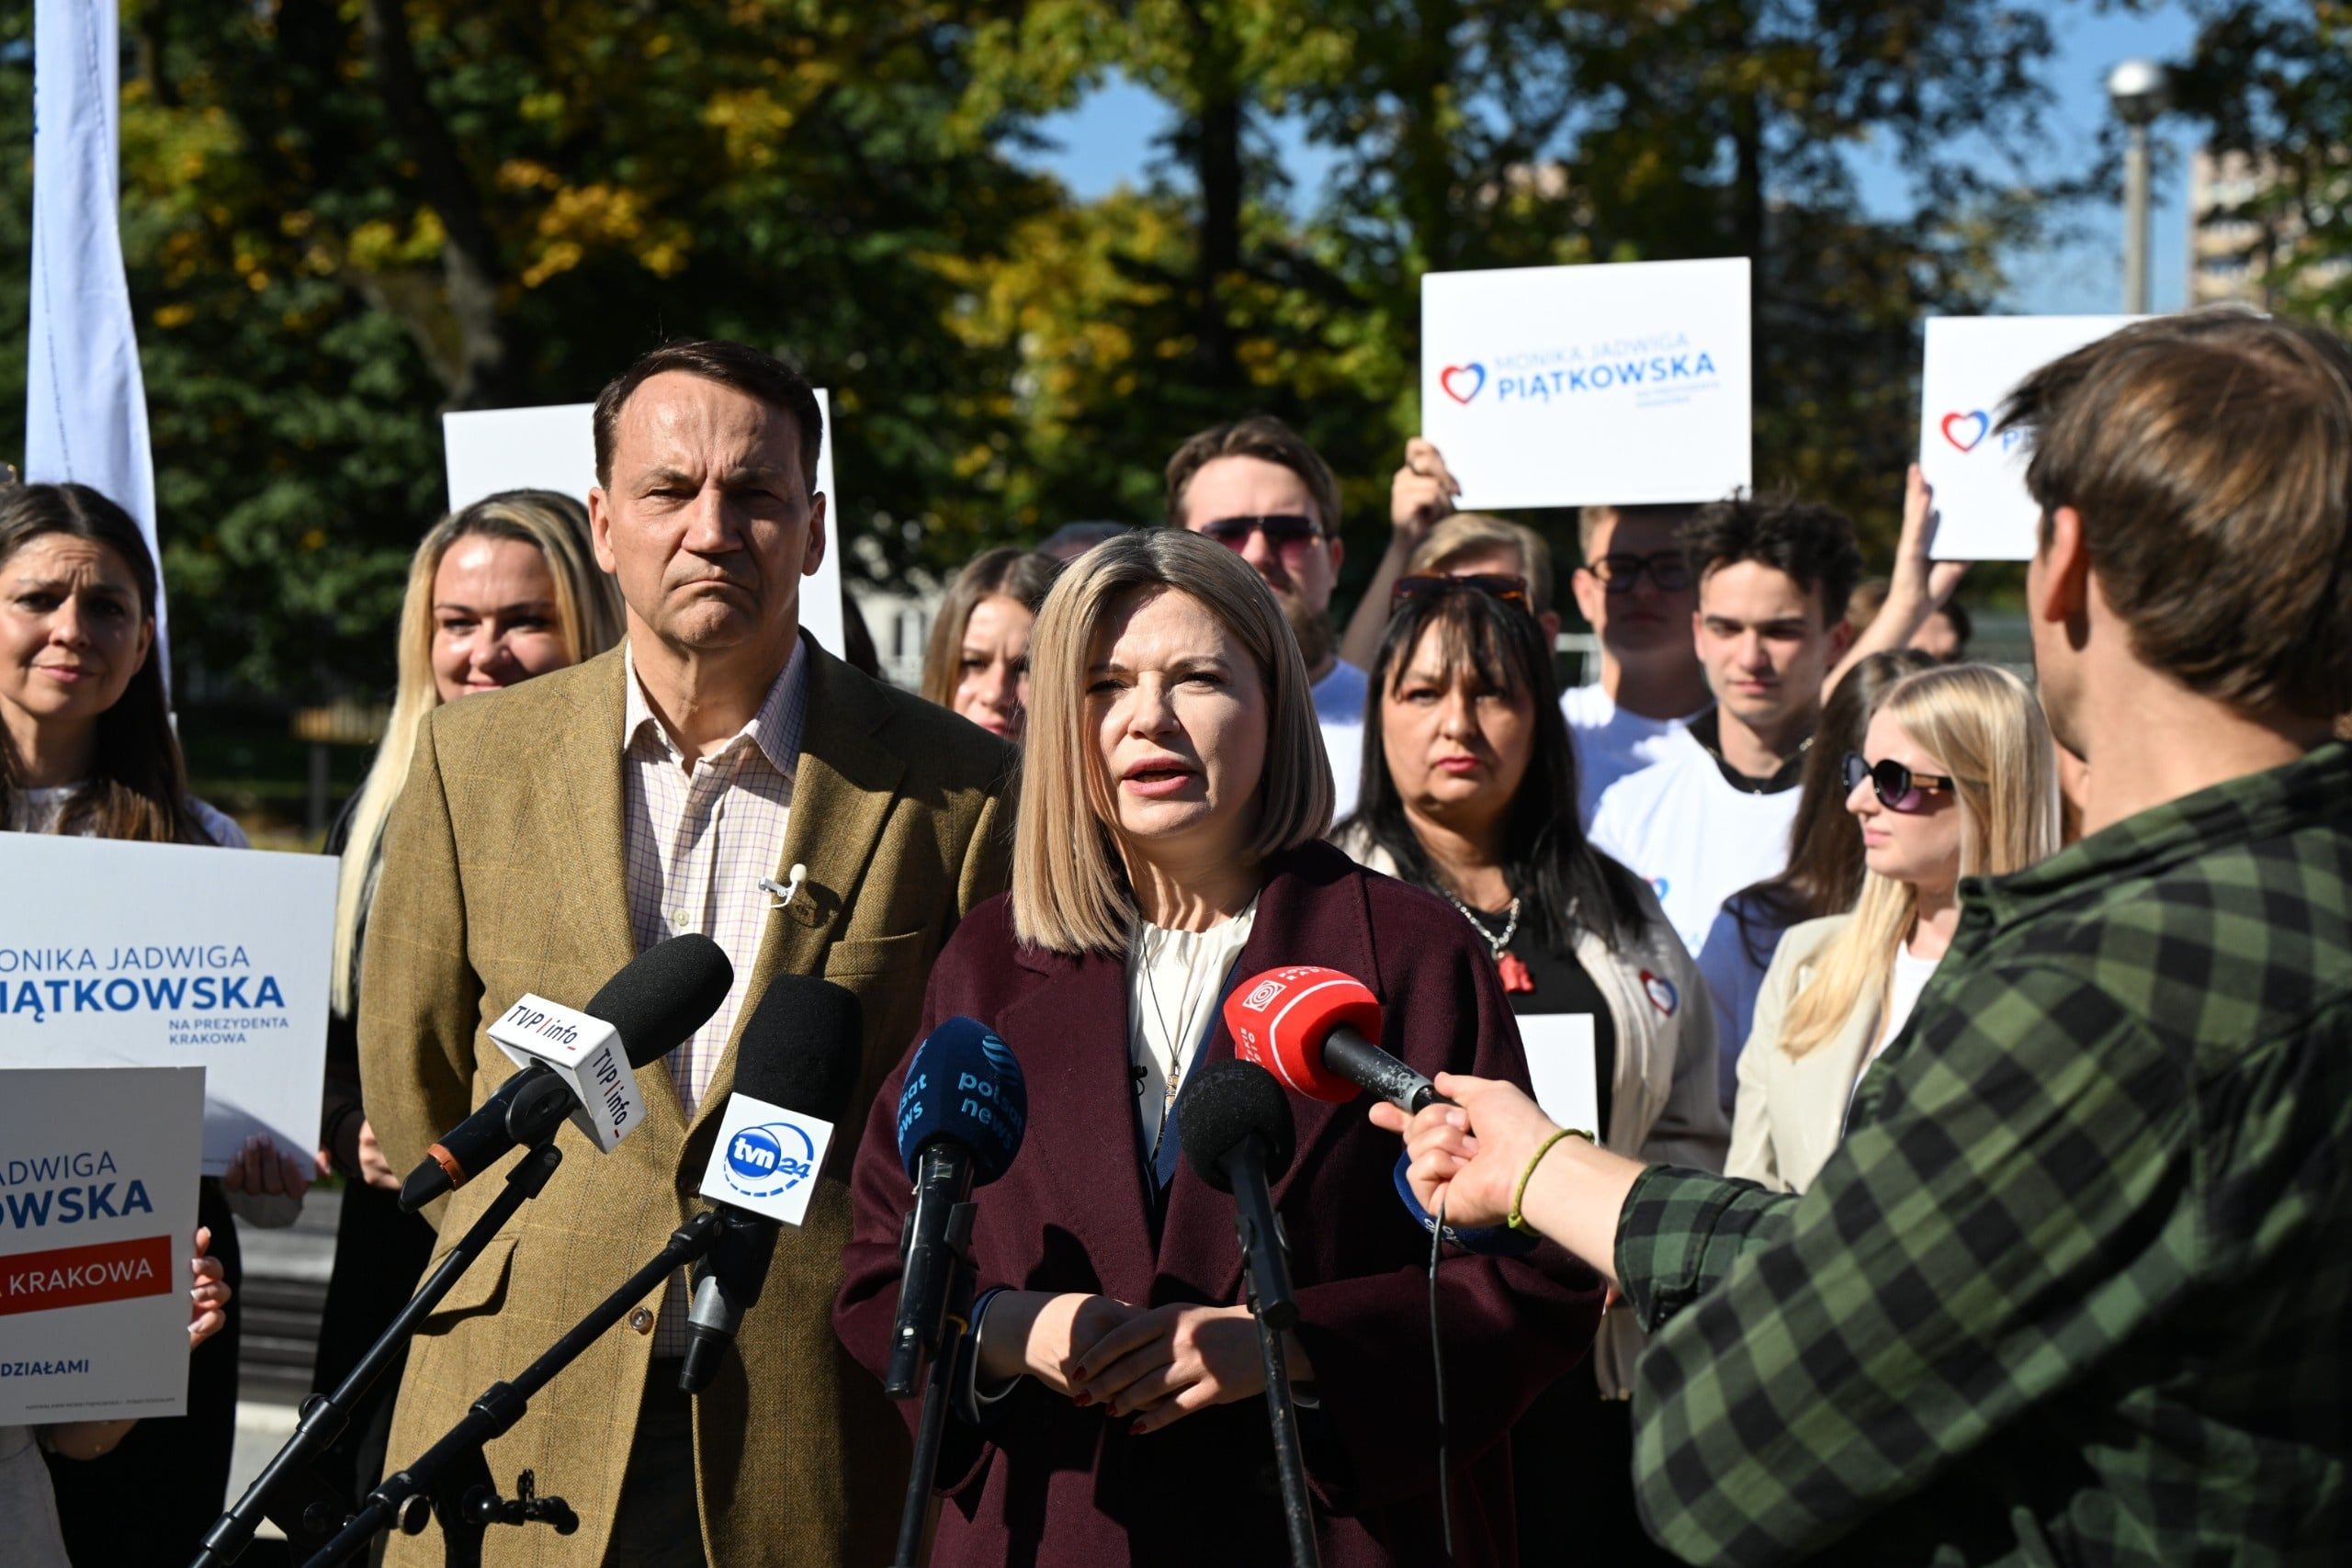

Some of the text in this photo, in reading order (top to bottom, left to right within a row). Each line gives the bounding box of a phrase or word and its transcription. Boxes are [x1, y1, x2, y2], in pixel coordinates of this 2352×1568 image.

[1498, 353, 1716, 404] PIĄTKOWSKA
[107, 945, 250, 971] JADWIGA
[169, 1018, 288, 1030] NA PREZYDENTA
[169, 1032, 246, 1044] KRAKOWA
[507, 1005, 578, 1044] TVP info
[592, 1048, 630, 1126] TVP info
[10, 1258, 153, 1295] KRAKOWA
